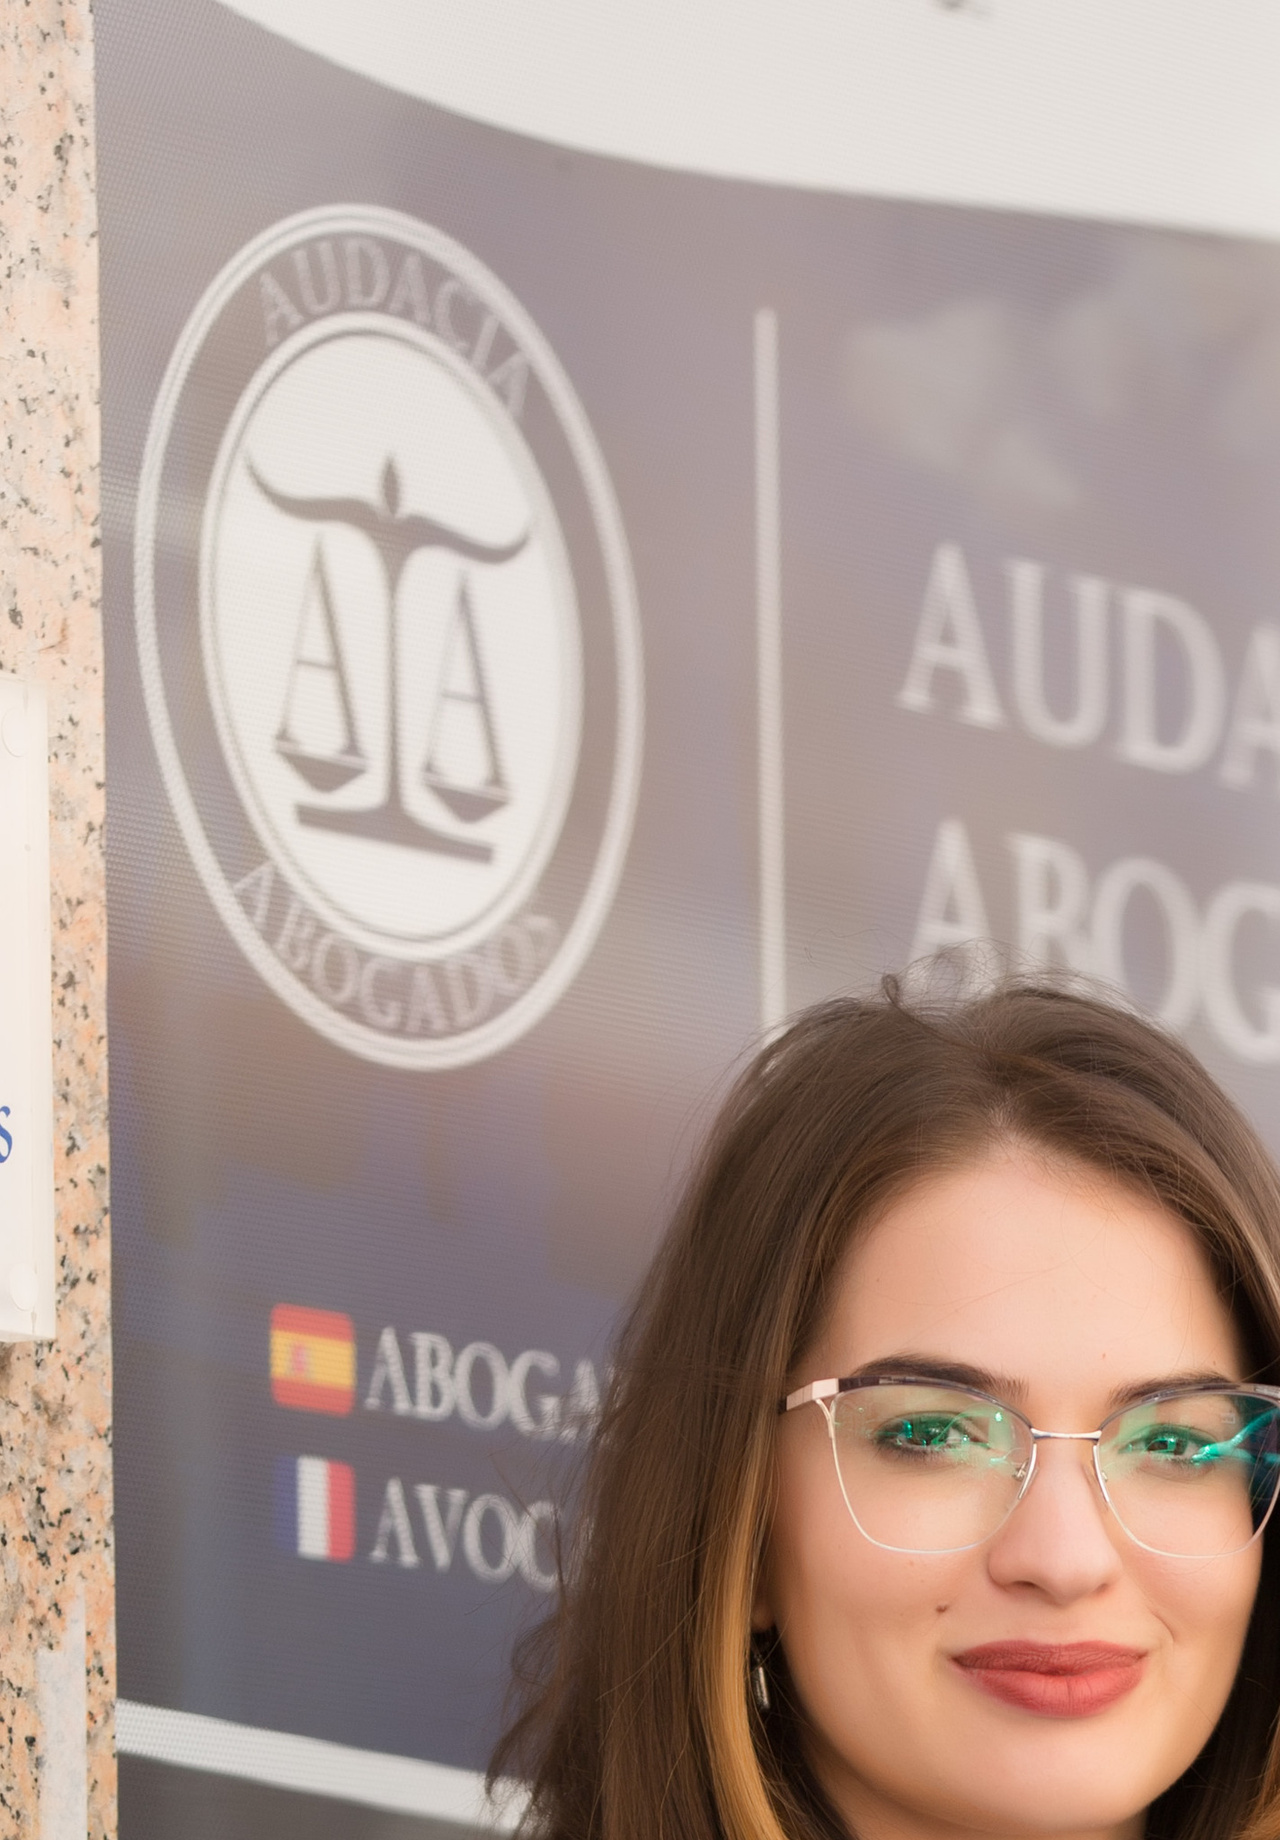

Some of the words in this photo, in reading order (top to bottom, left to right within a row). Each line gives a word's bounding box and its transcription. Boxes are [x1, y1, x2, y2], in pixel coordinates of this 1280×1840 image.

[258, 236, 532, 416] AUDACIA
[233, 861, 562, 1034] ABOGADOS
[364, 1326, 620, 1447] ABOGA
[370, 1477, 592, 1594] AVOC
